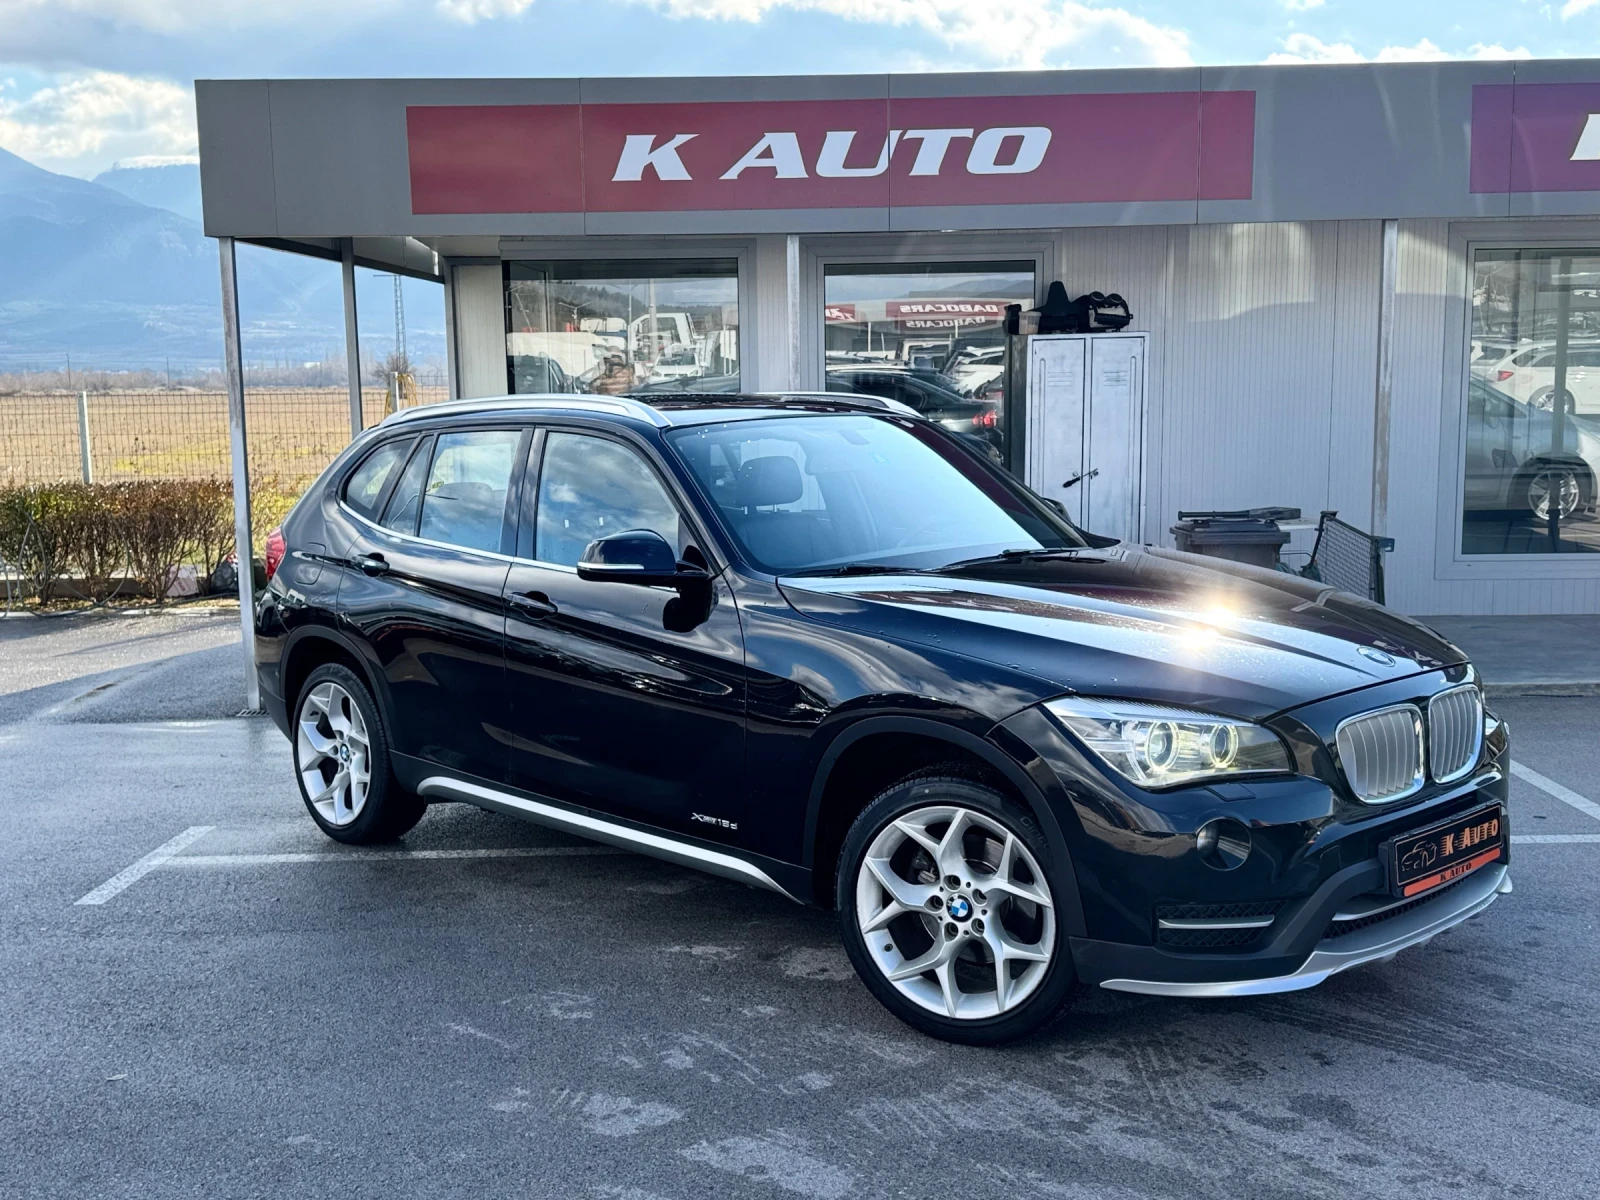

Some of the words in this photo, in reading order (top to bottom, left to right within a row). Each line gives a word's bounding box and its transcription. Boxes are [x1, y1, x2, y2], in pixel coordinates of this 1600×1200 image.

[611, 133, 699, 181] K
[718, 126, 1052, 180] AUTO
[1449, 863, 1472, 877] AUTO
